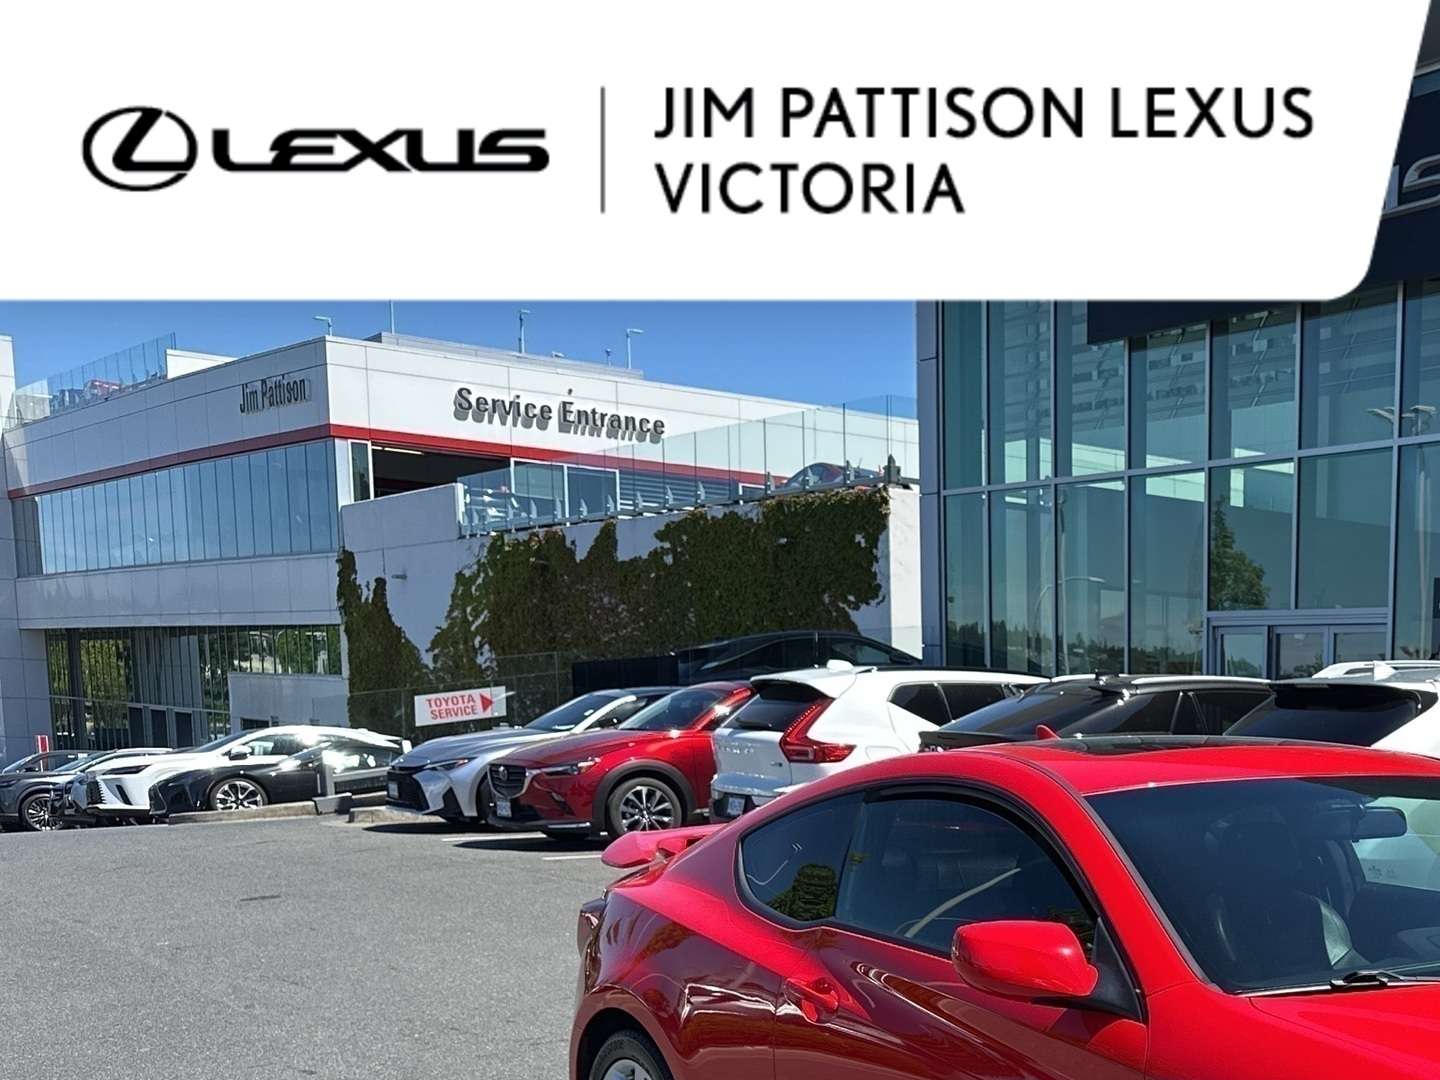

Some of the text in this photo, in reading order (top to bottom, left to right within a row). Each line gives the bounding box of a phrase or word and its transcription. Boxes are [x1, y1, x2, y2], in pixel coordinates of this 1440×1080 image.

[240, 374, 307, 413] Jim Pattison
[455, 387, 665, 436] Service Entrance
[425, 693, 476, 709] TOYOTA
[430, 704, 478, 721] SERVICE
